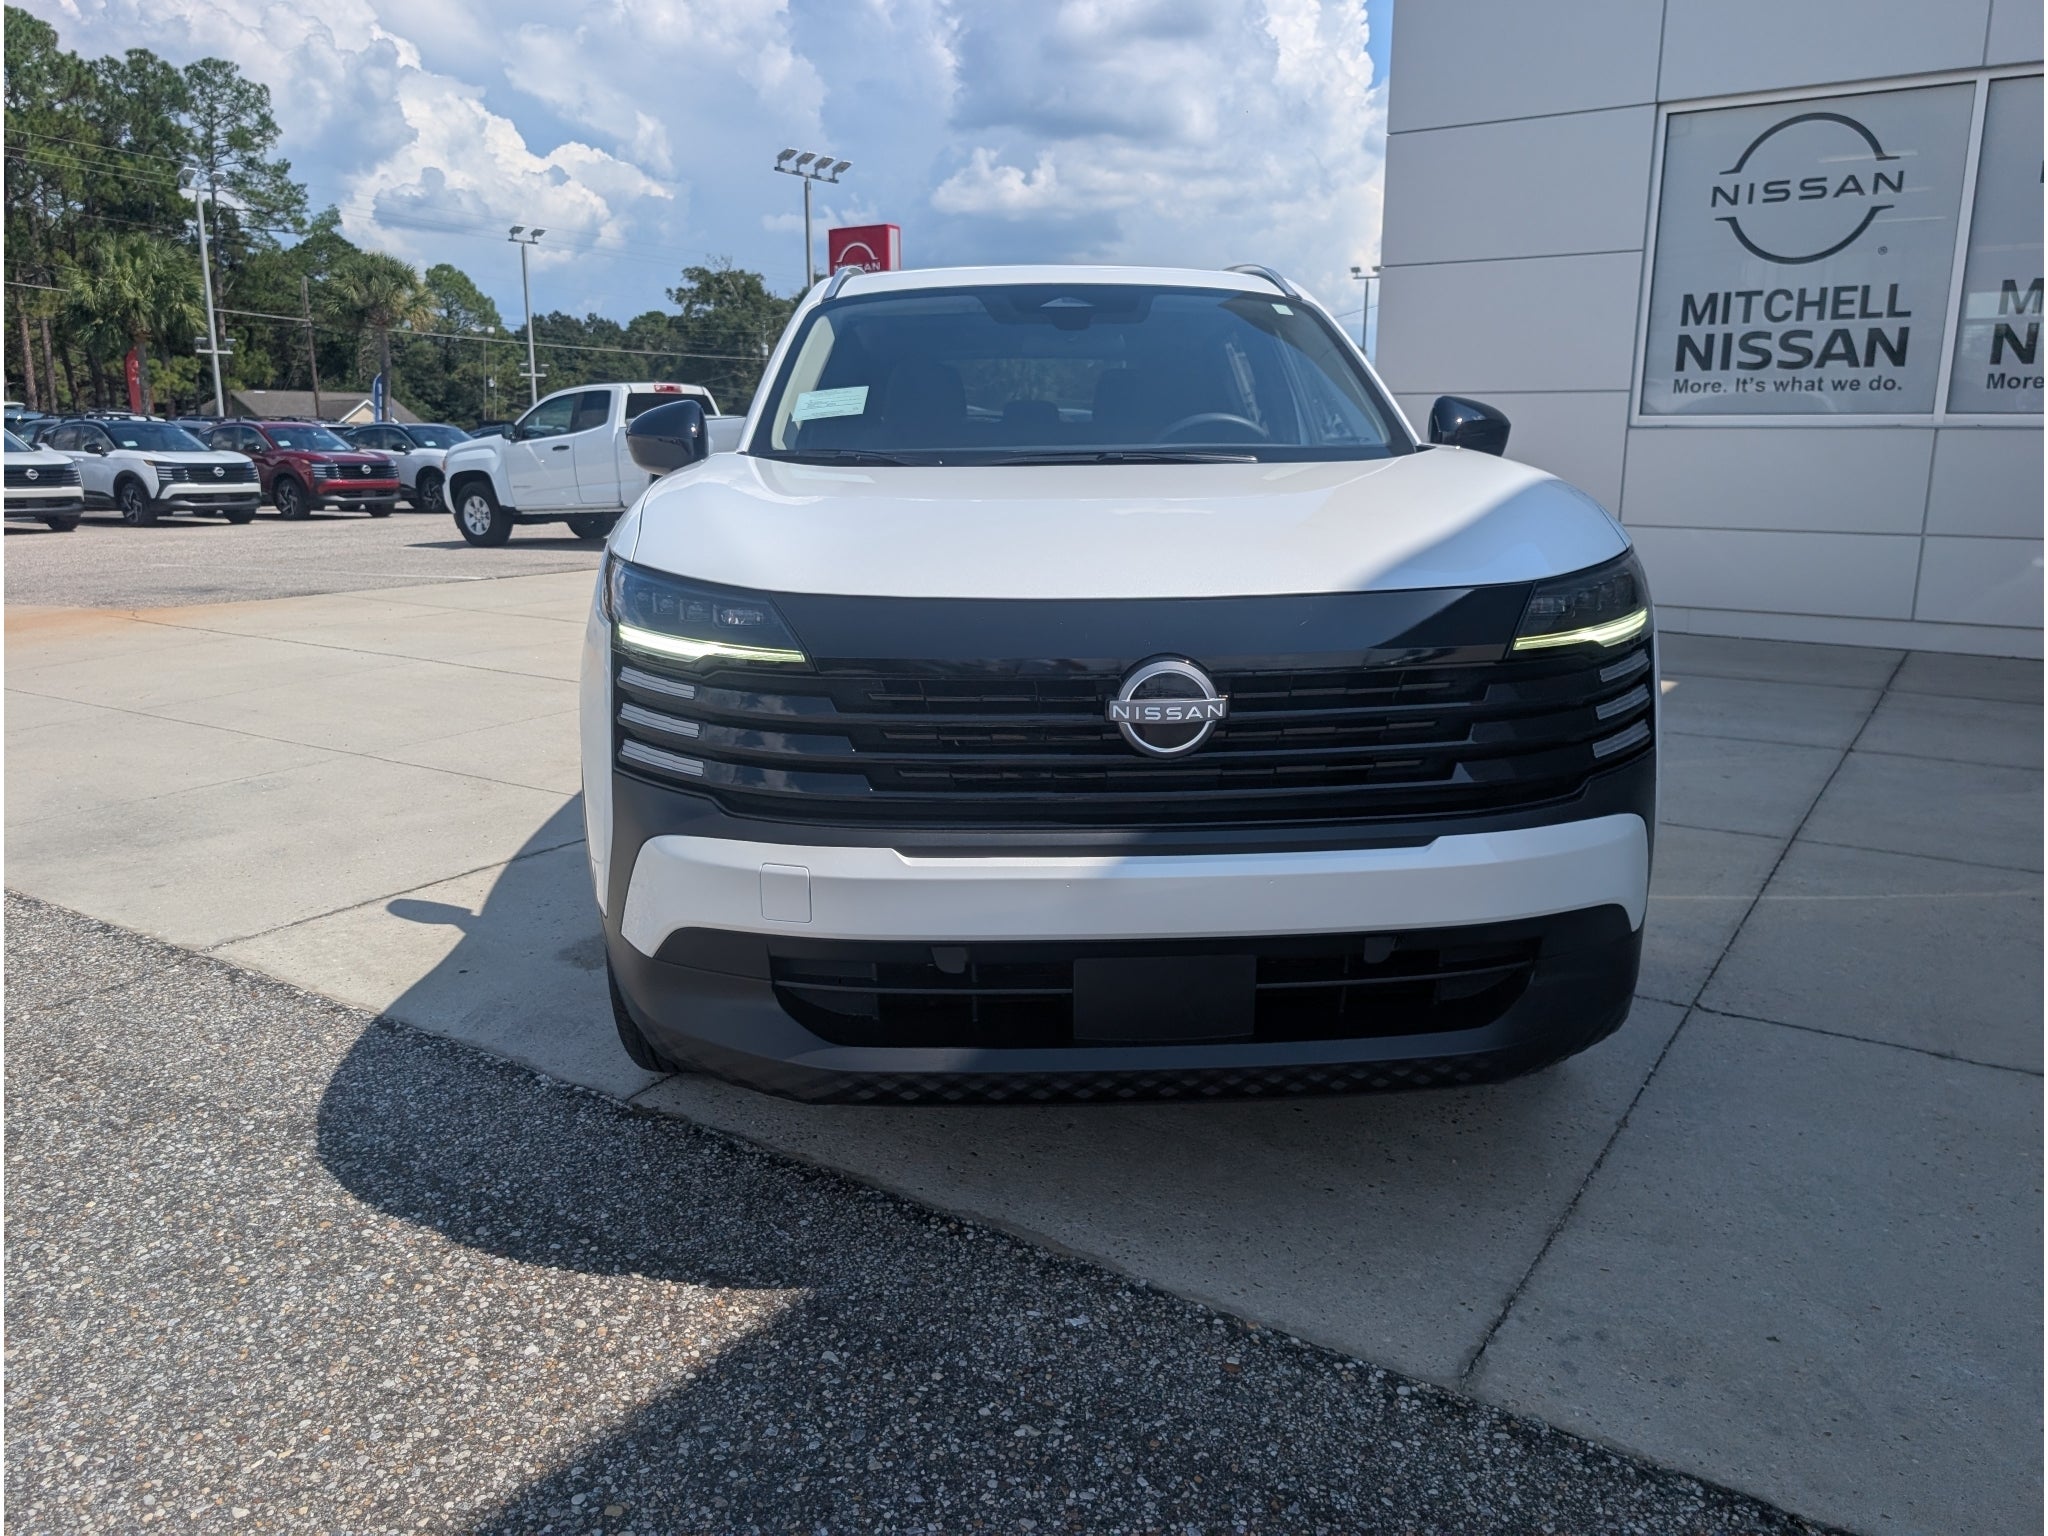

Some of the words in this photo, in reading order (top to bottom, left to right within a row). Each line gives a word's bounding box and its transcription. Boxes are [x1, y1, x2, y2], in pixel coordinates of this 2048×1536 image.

[1710, 170, 1905, 208] NISSAN
[1680, 283, 1912, 326] MITCHELL
[1674, 326, 1911, 372] NISSAN
[1672, 378, 1728, 394] More.
[1735, 376, 1766, 393] It's
[1773, 376, 1824, 392] what
[1831, 378, 1861, 391] we
[1868, 374, 1903, 391] do.
[1112, 703, 1223, 720] NISSAN
